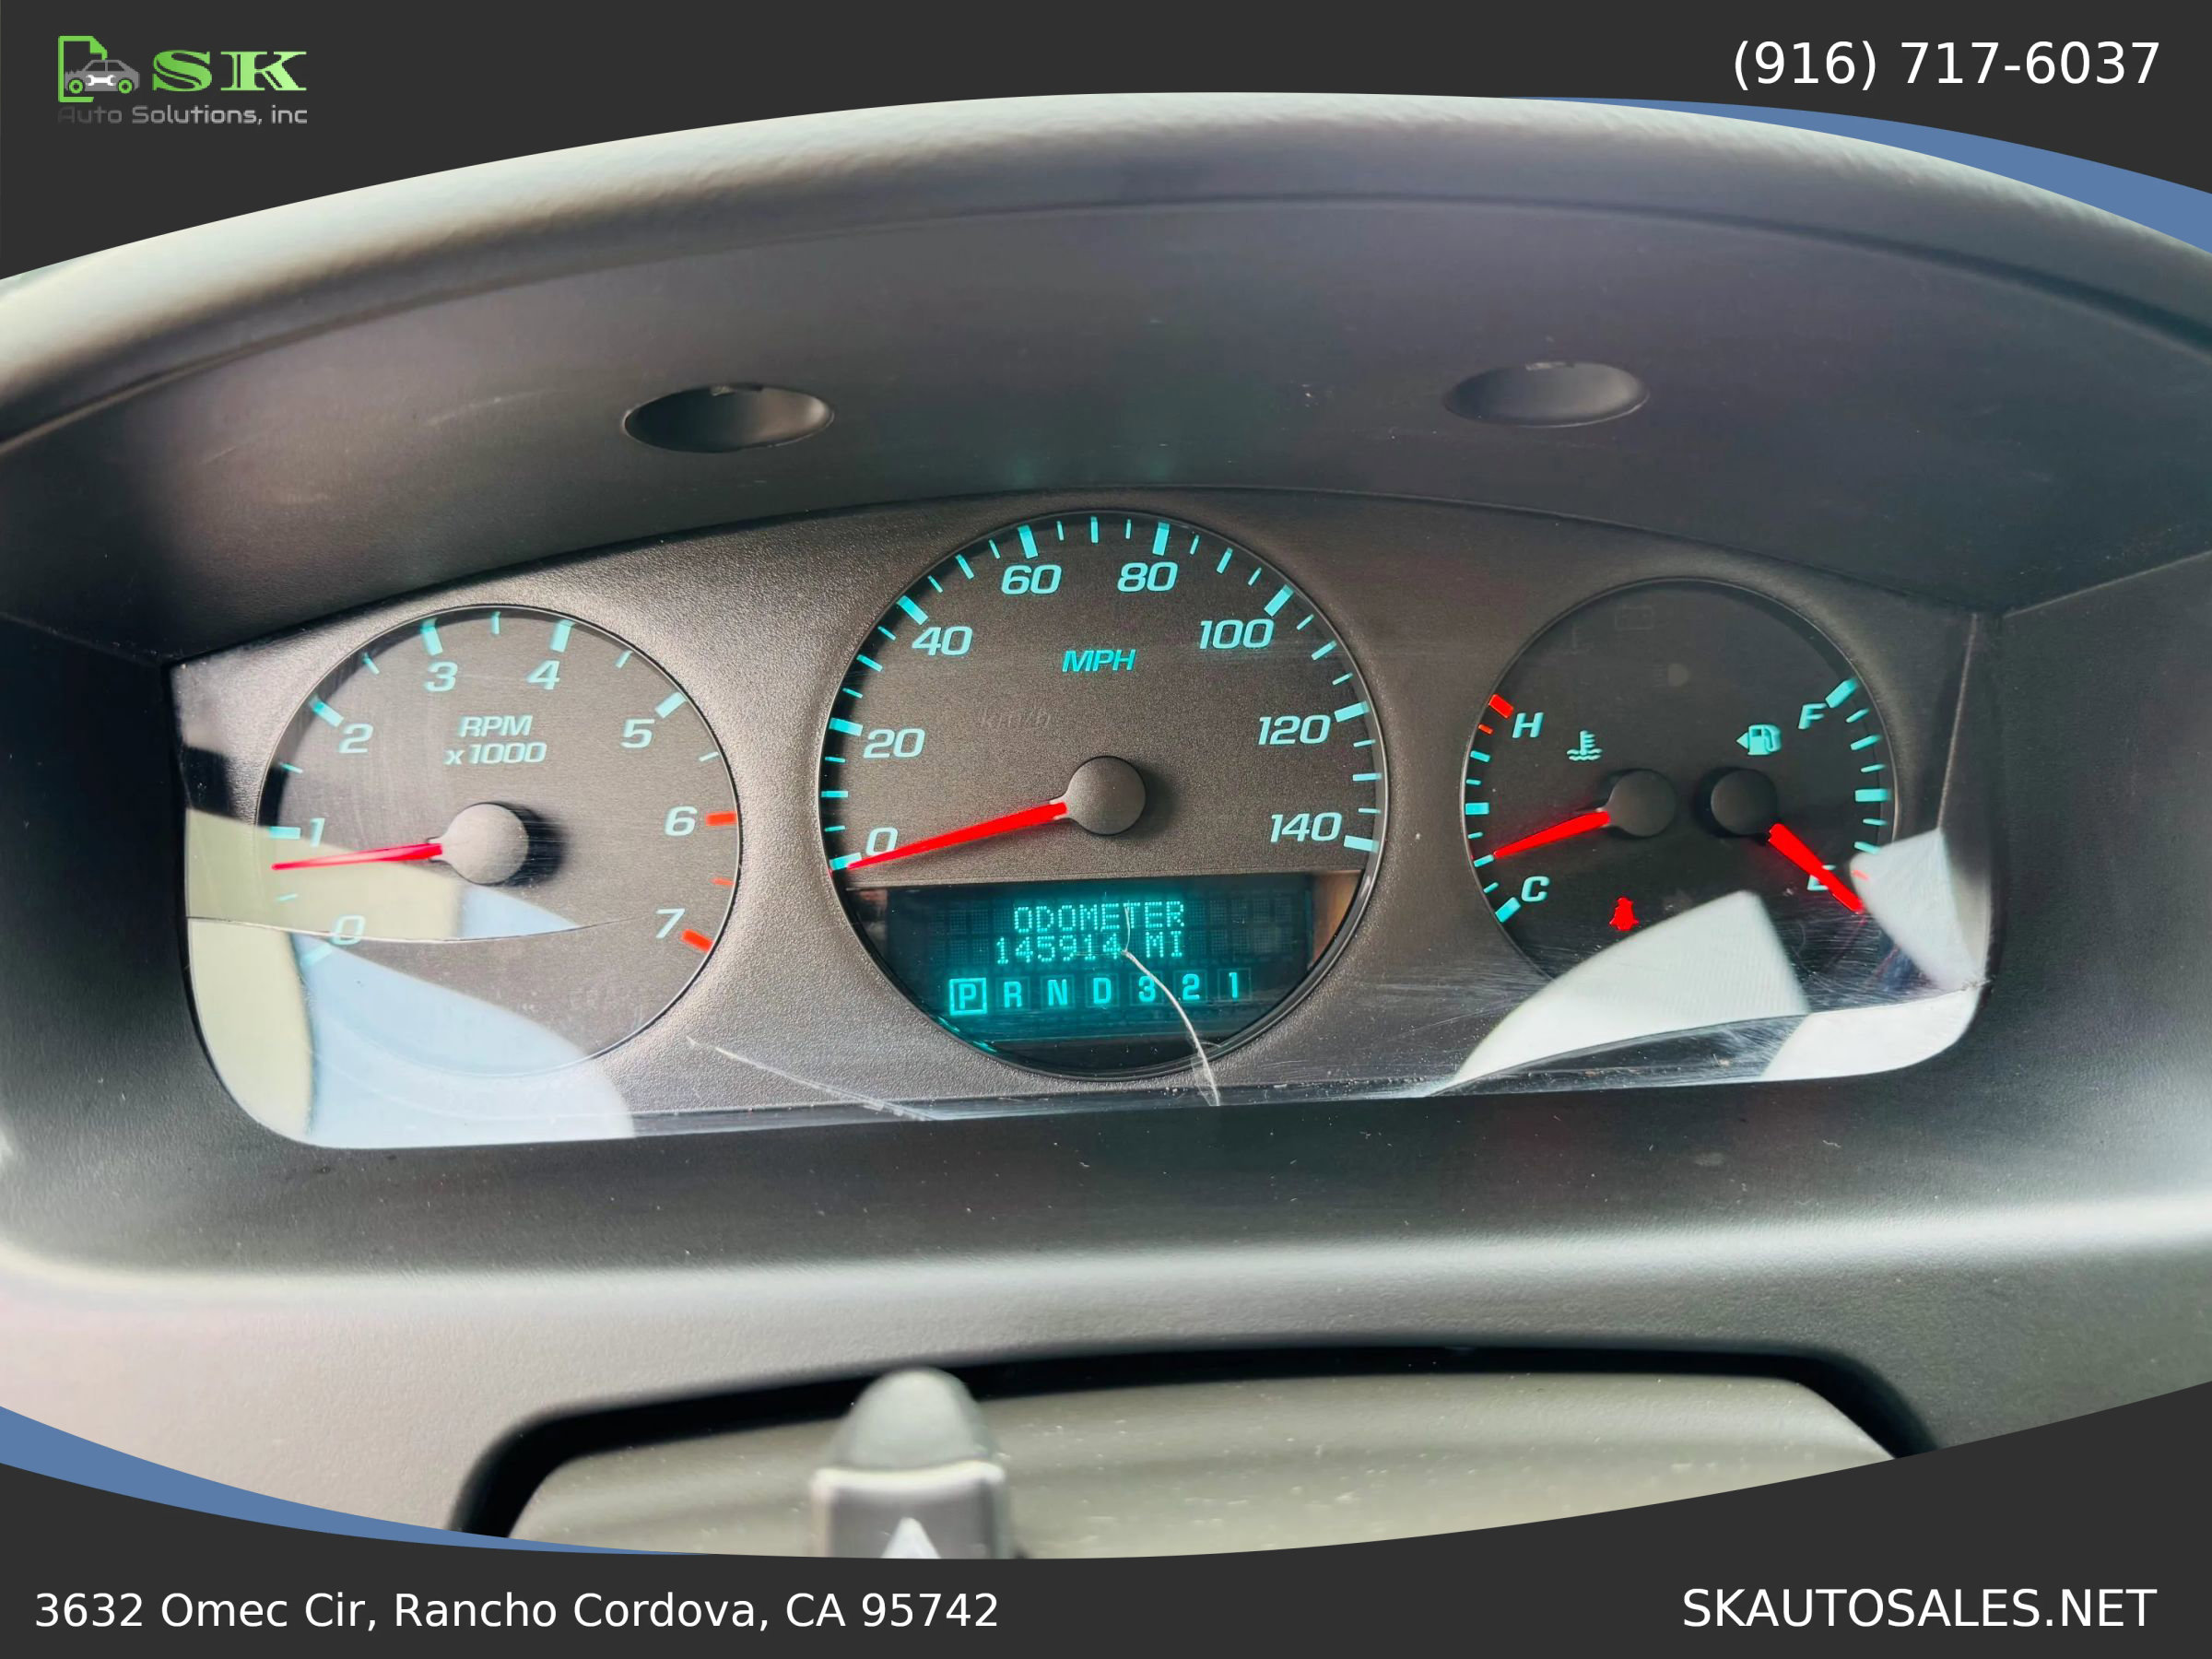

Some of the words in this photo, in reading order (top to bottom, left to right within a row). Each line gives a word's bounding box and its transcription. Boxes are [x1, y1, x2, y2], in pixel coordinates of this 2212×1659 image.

[1001, 564, 1062, 595] 60
[1117, 560, 1179, 594] 80
[912, 626, 973, 656] 40
[1199, 618, 1275, 649] 100
[526, 661, 560, 690] 4
[1062, 648, 1137, 674] MPH
[424, 661, 457, 692] 3
[458, 715, 533, 737] RPM
[1258, 715, 1330, 745] 120
[1512, 712, 1545, 738] H
[1798, 702, 1827, 730] F
[338, 724, 373, 754] 2
[620, 719, 655, 748] 5
[864, 729, 924, 758] 20
[309, 818, 324, 846] 1
[664, 807, 697, 837] 6
[1270, 812, 1342, 842] 140
[866, 827, 898, 855] 0
[1522, 876, 1550, 902] C
[332, 916, 365, 946] 0
[657, 910, 685, 939] 7
[1014, 900, 1185, 933] ODOMETER
[996, 934, 1122, 965] 145914
[1146, 930, 1183, 959] MI
[959, 983, 977, 1008] P
[1004, 982, 1022, 1008] R
[1048, 980, 1067, 1006] N
[1093, 978, 1112, 1004] D
[1138, 976, 1156, 1002] 3
[1182, 973, 1199, 1001] 2
[1229, 971, 1239, 998] 1
